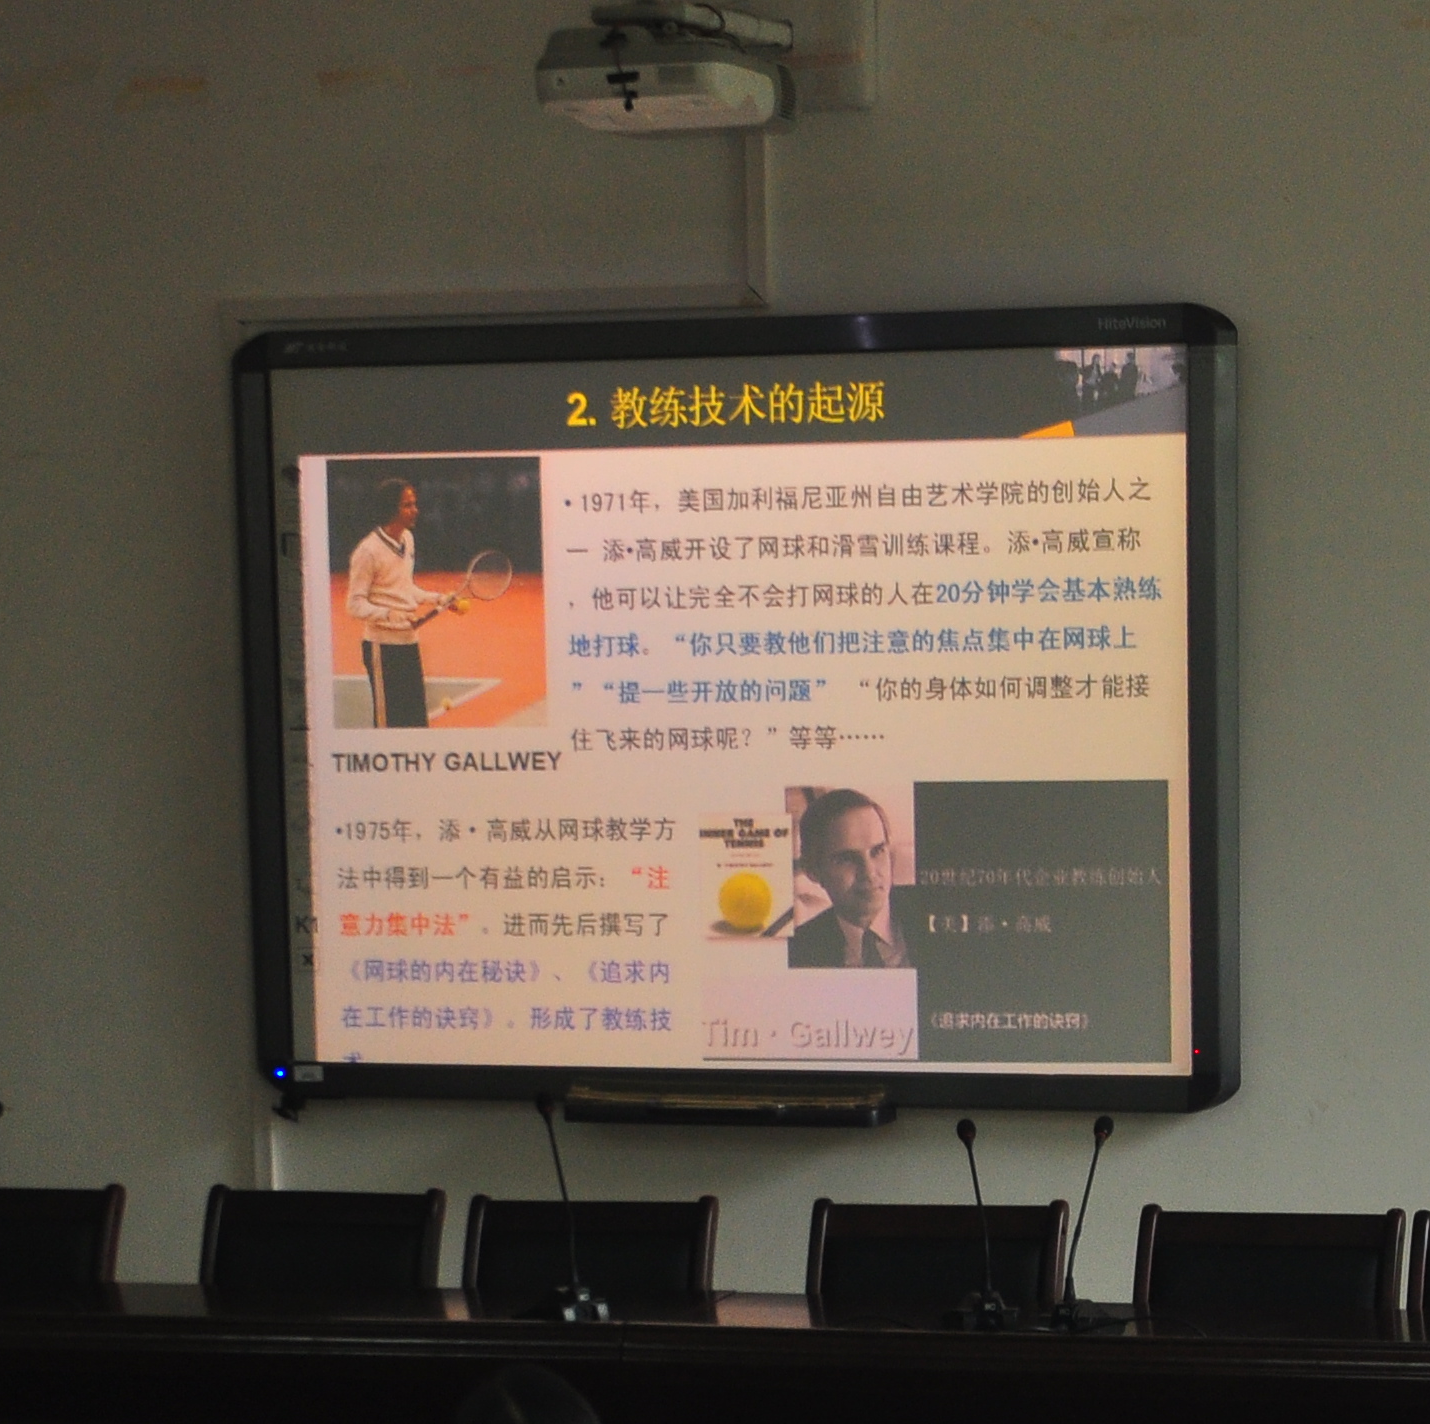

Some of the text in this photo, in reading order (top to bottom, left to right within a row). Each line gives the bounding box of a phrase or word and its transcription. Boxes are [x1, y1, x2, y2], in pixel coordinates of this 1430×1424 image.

[1097, 316, 1167, 330] HiteVision
[566, 380, 886, 429] 2. 教练技术的起源
[332, 751, 563, 773] TIMOTHY GALLWEY
[702, 1019, 914, 1056] Tim Gallwey
